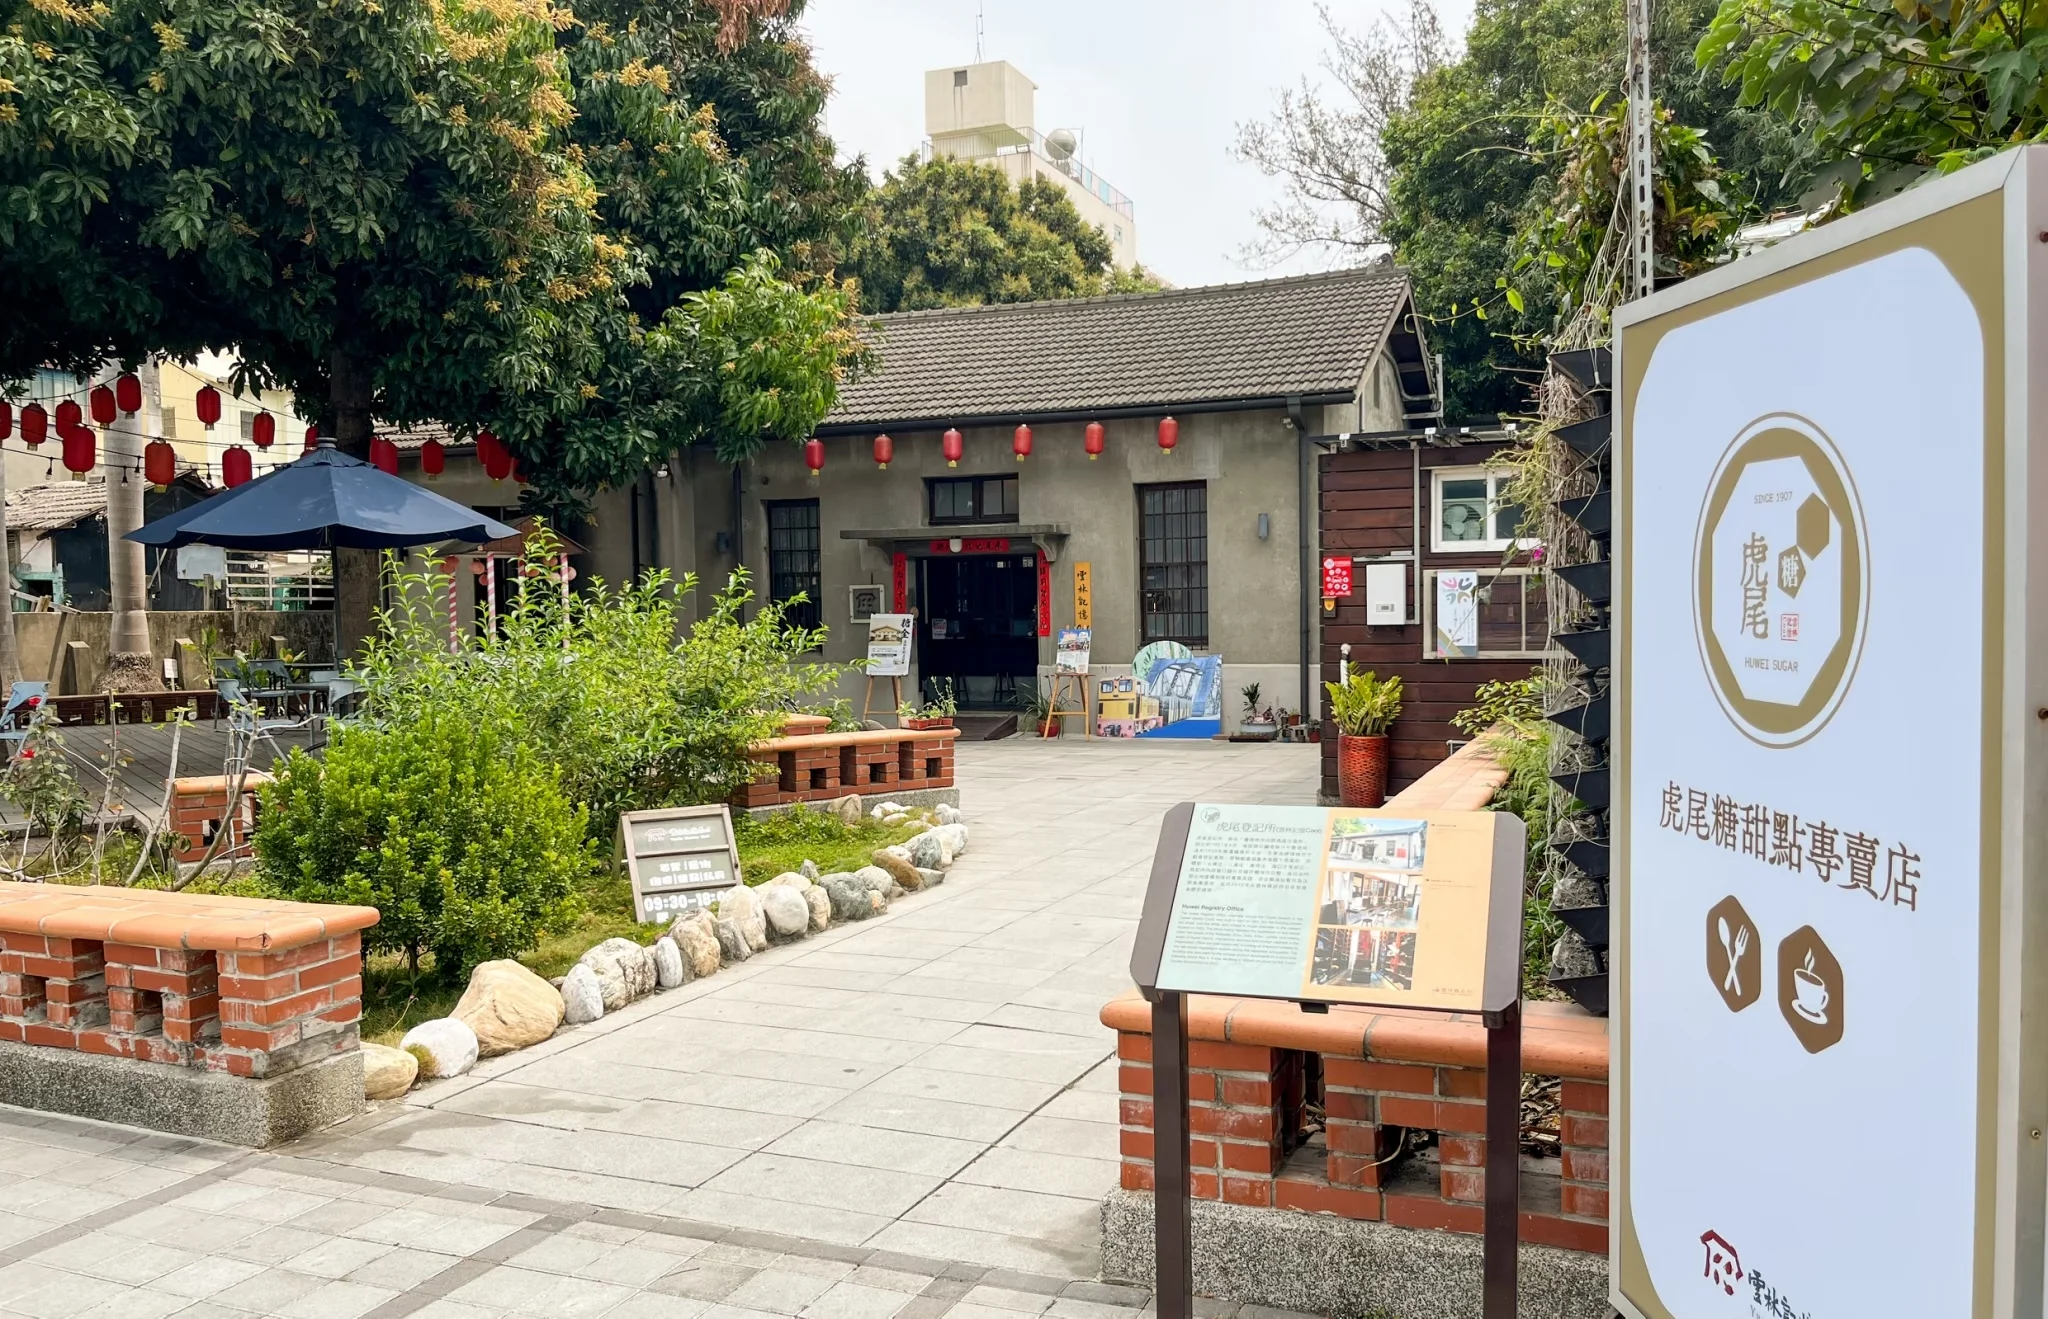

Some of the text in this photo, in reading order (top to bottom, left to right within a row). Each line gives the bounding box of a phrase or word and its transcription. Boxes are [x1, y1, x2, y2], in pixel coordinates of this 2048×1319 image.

[1753, 490, 1793, 504] SINCE 1907
[1740, 532, 1768, 640] 虎尾
[1780, 554, 1799, 589] 糖
[1744, 657, 1799, 673] HUWEI SUGAR
[1659, 780, 1922, 912] 虎尾糖甜點專賣店
[1748, 1268, 1812, 1319] 雲林記
